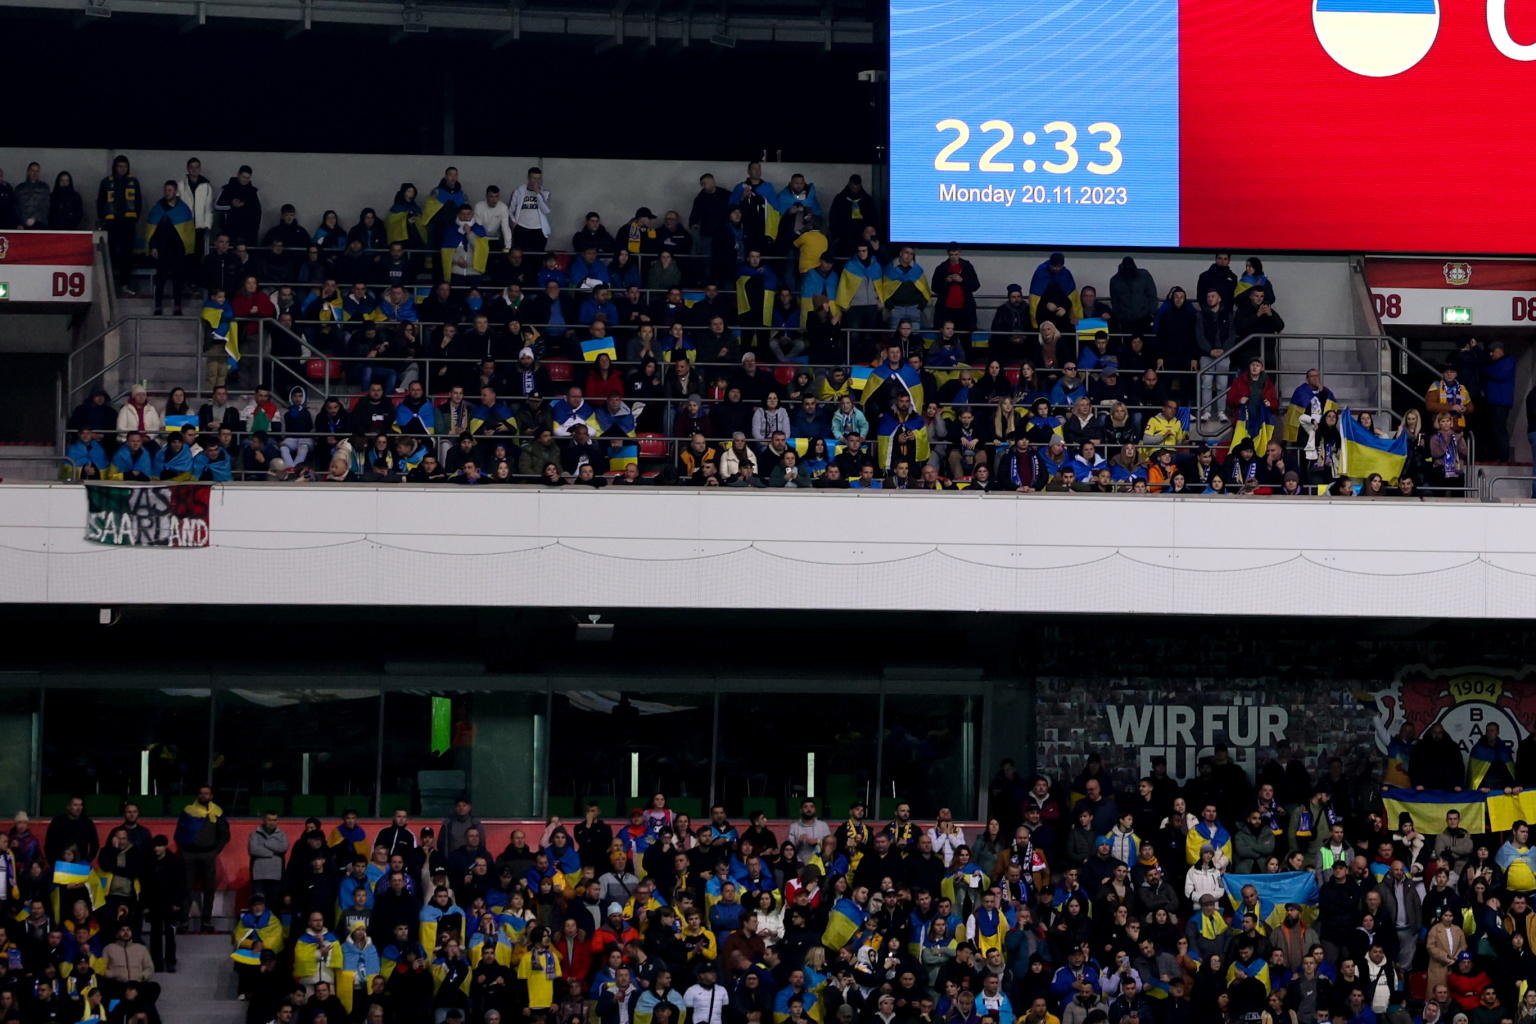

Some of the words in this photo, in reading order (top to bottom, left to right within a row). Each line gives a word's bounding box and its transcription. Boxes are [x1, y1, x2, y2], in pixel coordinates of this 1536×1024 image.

[934, 118, 1123, 175] 22:33
[939, 184, 1016, 207] Monday
[1021, 185, 1128, 206] 20.11.2023
[53, 271, 86, 297] D9
[1372, 293, 1402, 319] D8
[88, 510, 209, 547] SAARLAND
[1453, 680, 1497, 697] 1904
[1106, 704, 1198, 746] WIR
[1202, 695, 1289, 746] FÜR
